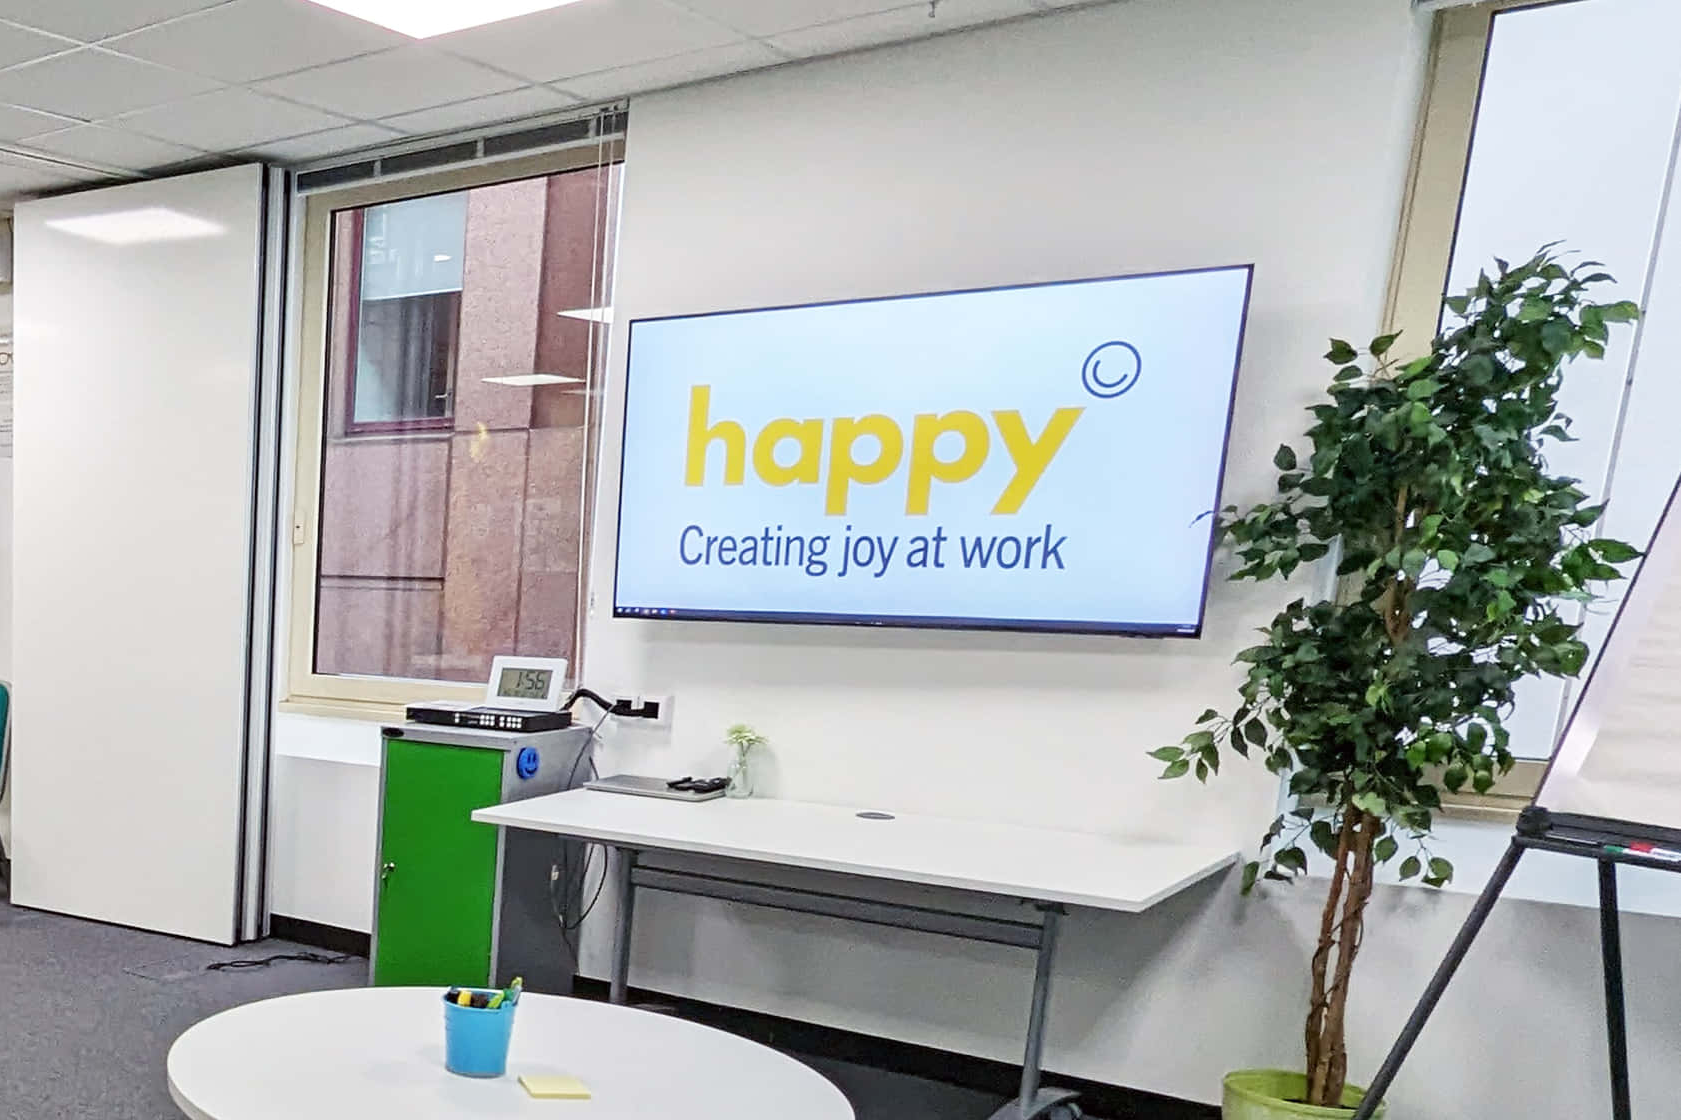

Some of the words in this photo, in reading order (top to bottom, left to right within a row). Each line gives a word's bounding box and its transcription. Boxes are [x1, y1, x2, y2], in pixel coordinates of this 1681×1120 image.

[682, 383, 1085, 517] happy
[679, 524, 830, 578] Creating
[837, 525, 898, 577] joy
[906, 527, 948, 570] at
[959, 524, 1068, 571] work
